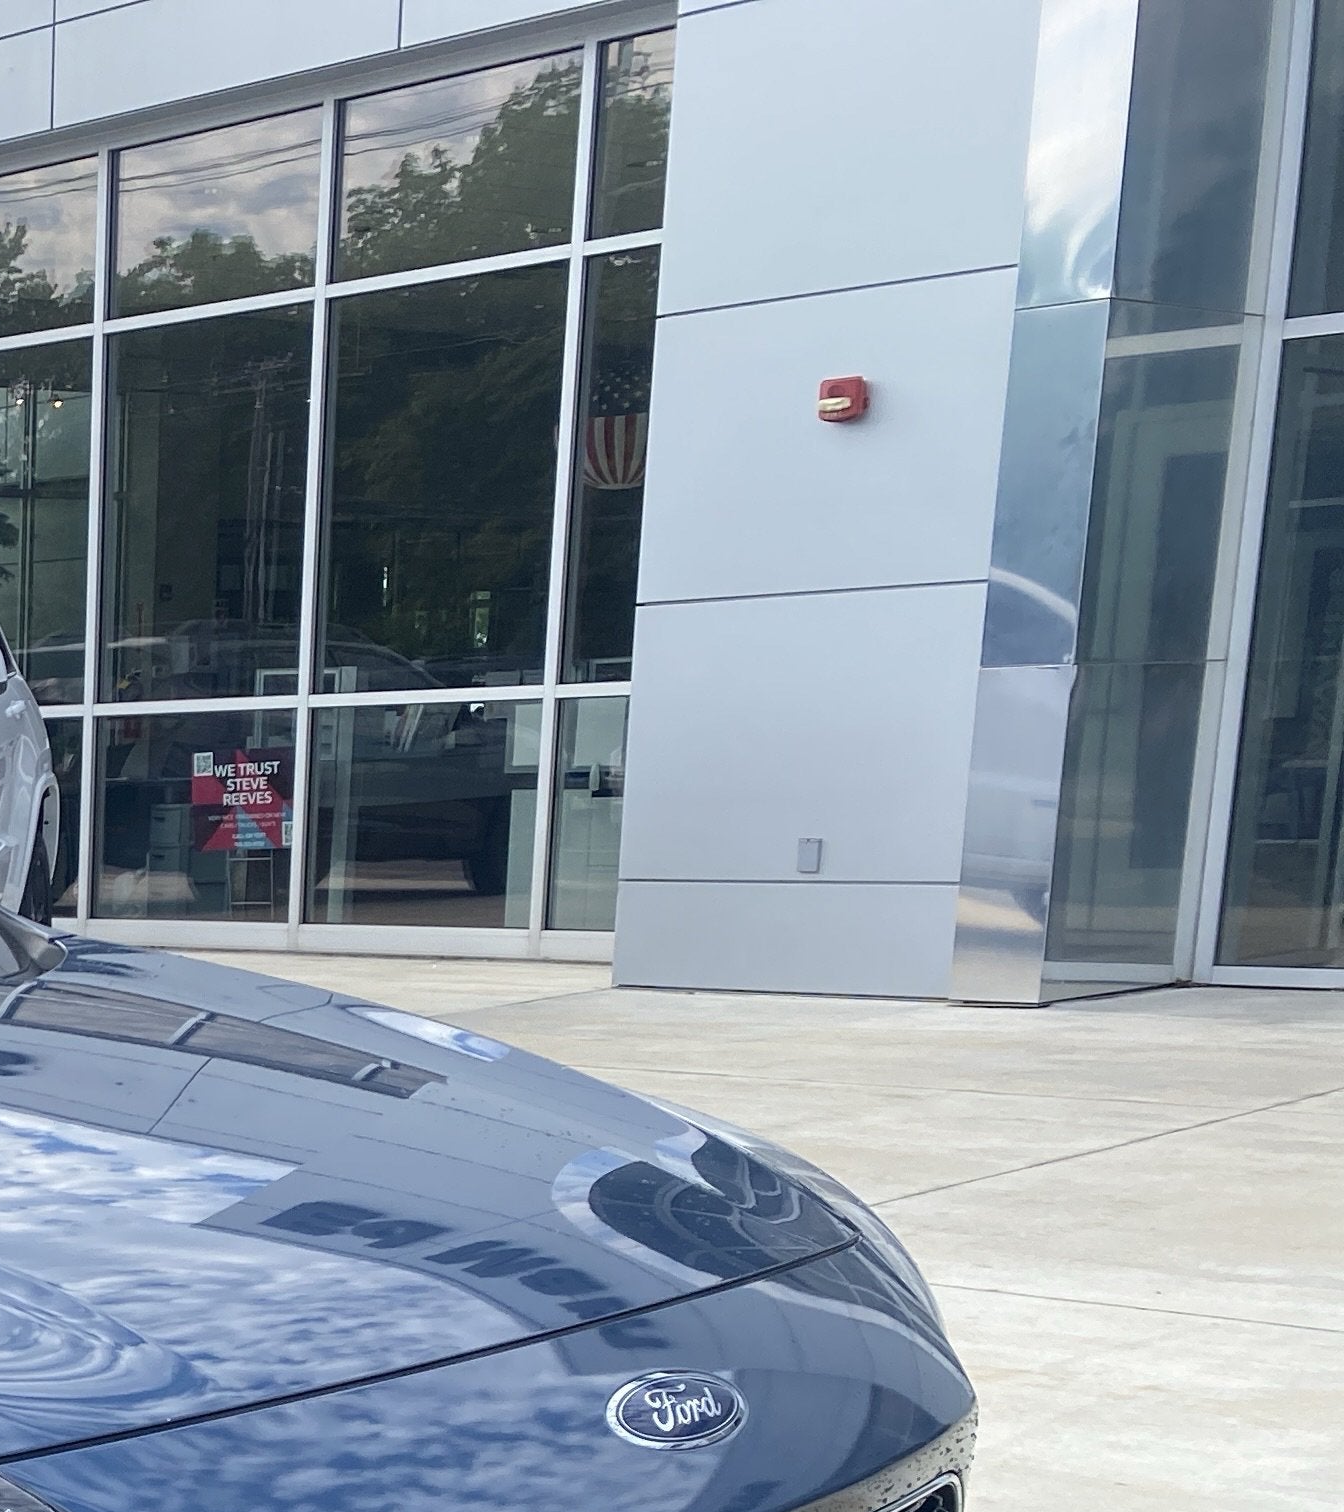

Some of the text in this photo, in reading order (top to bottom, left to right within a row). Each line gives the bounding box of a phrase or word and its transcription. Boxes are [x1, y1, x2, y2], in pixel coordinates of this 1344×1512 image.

[214, 761, 280, 777] WE TRUST
[227, 777, 268, 791] STEVE
[223, 791, 273, 806] REEVES
[644, 1383, 722, 1432] Ford
